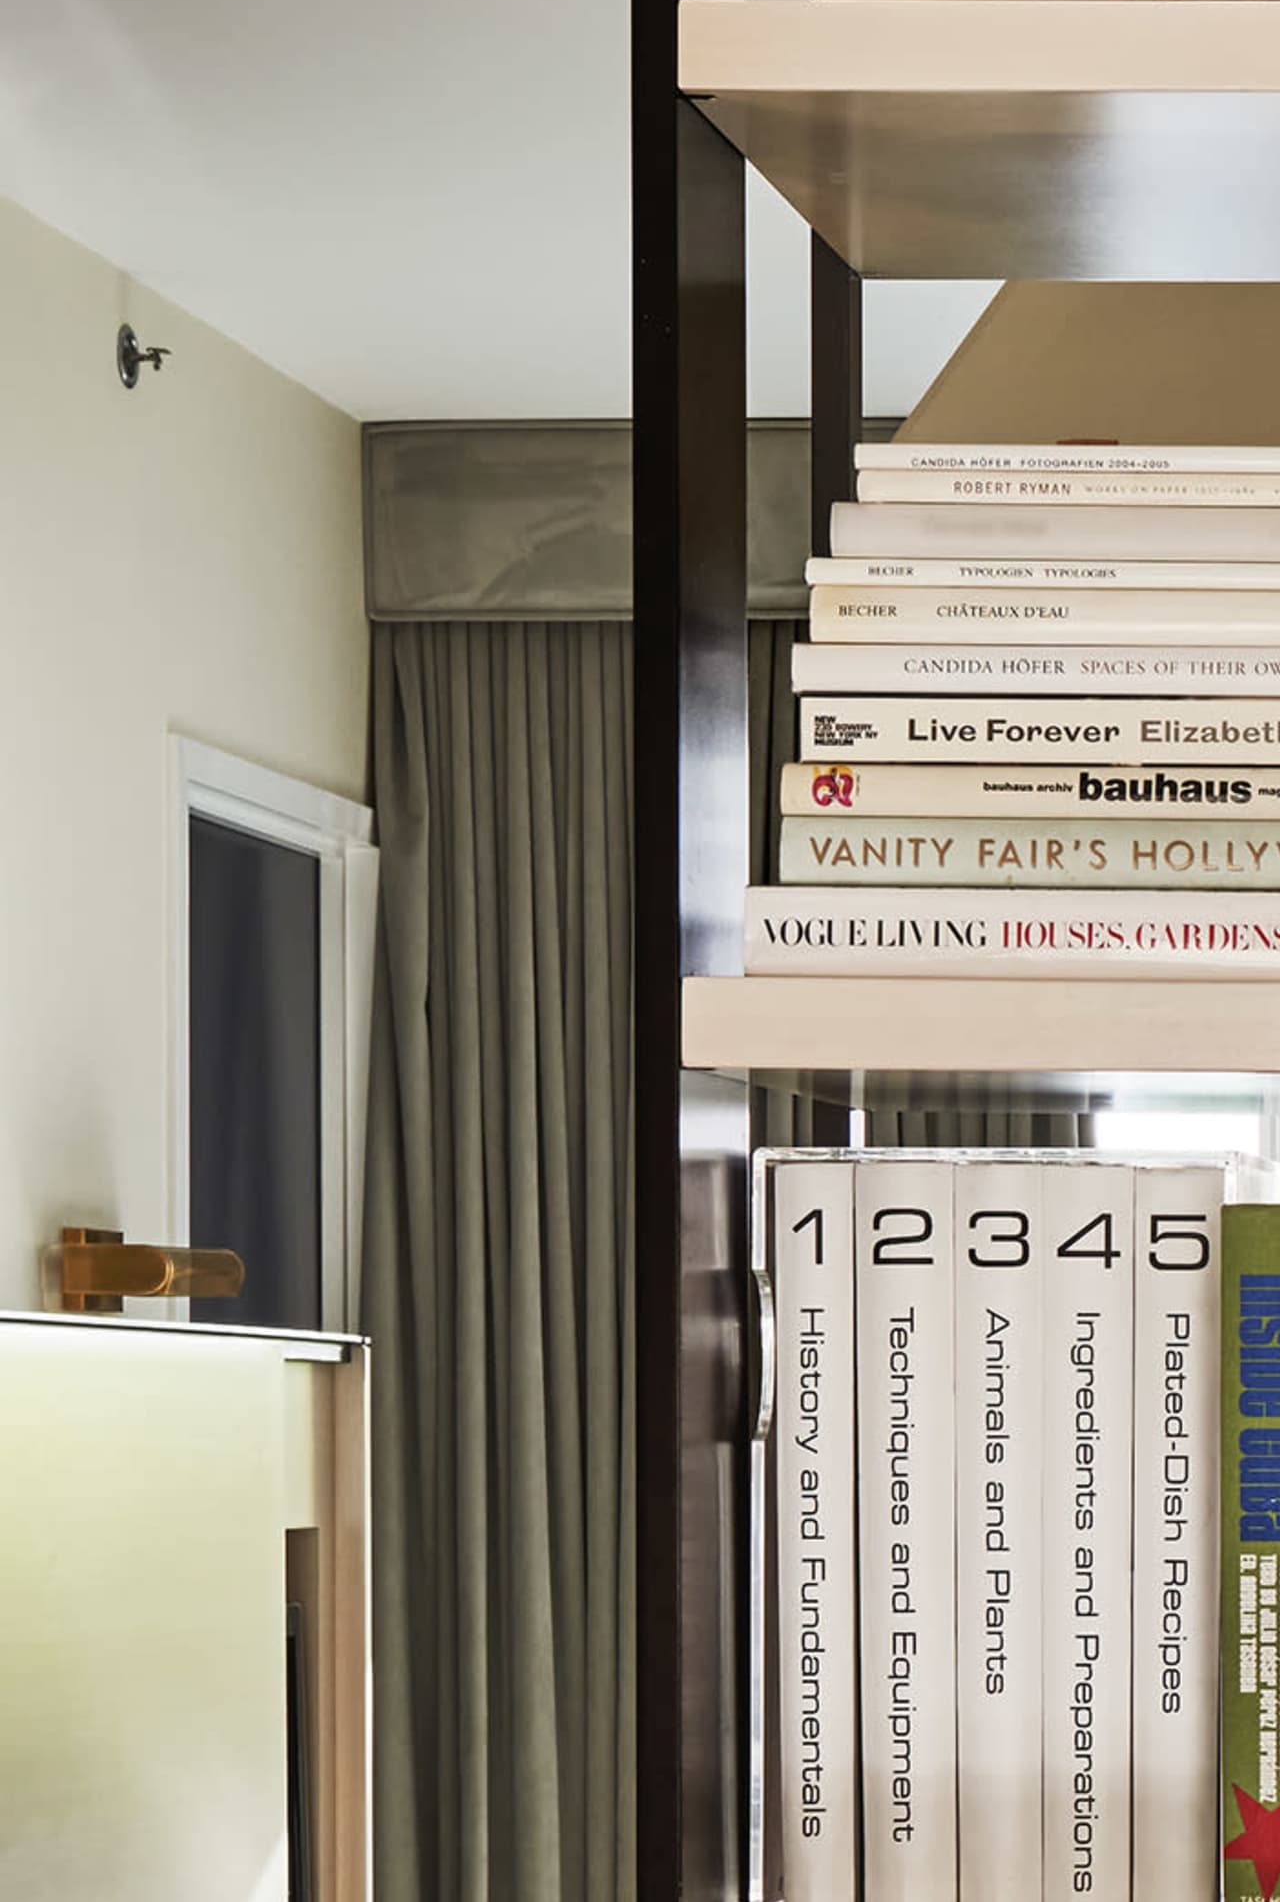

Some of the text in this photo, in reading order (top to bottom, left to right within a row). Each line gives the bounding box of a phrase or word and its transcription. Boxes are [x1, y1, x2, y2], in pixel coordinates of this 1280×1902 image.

[912, 457, 966, 468] CANDIDA
[1021, 458, 1103, 469] FOTOGRAFIEN
[952, 480, 1010, 495] ROBERT
[1020, 483, 1070, 495] RYMAN
[839, 604, 1068, 618] BECHER CHÂTEAUX D'EAU
[904, 660, 992, 673] CANDIDA
[1003, 659, 1064, 674] HÖFER
[1081, 661, 1145, 674] SPACES
[1154, 661, 1178, 674] OF
[1188, 662, 1245, 675] THEIR
[909, 719, 1119, 742] Live Forever
[984, 782, 1073, 793] bauhaus archiv
[1077, 773, 1251, 805] bauhaus
[810, 837, 953, 867] VANITY
[979, 839, 1106, 869] FAIR'S
[764, 919, 985, 946] VOGUE LIVING
[793, 1209, 822, 1264] 1
[873, 1209, 933, 1265] 2
[969, 1211, 1029, 1267] 3
[1057, 1214, 1120, 1268] 4
[1149, 1215, 1209, 1270] 5
[986, 1309, 1010, 1694] Animals and Plants
[1159, 1314, 1190, 1713] Plated-Dish Recipes
[795, 1309, 826, 1837] History and Fundamentals
[886, 1307, 916, 1842] Techniques and Equipment
[1071, 1313, 1100, 1892] Ingredients and Preparations
